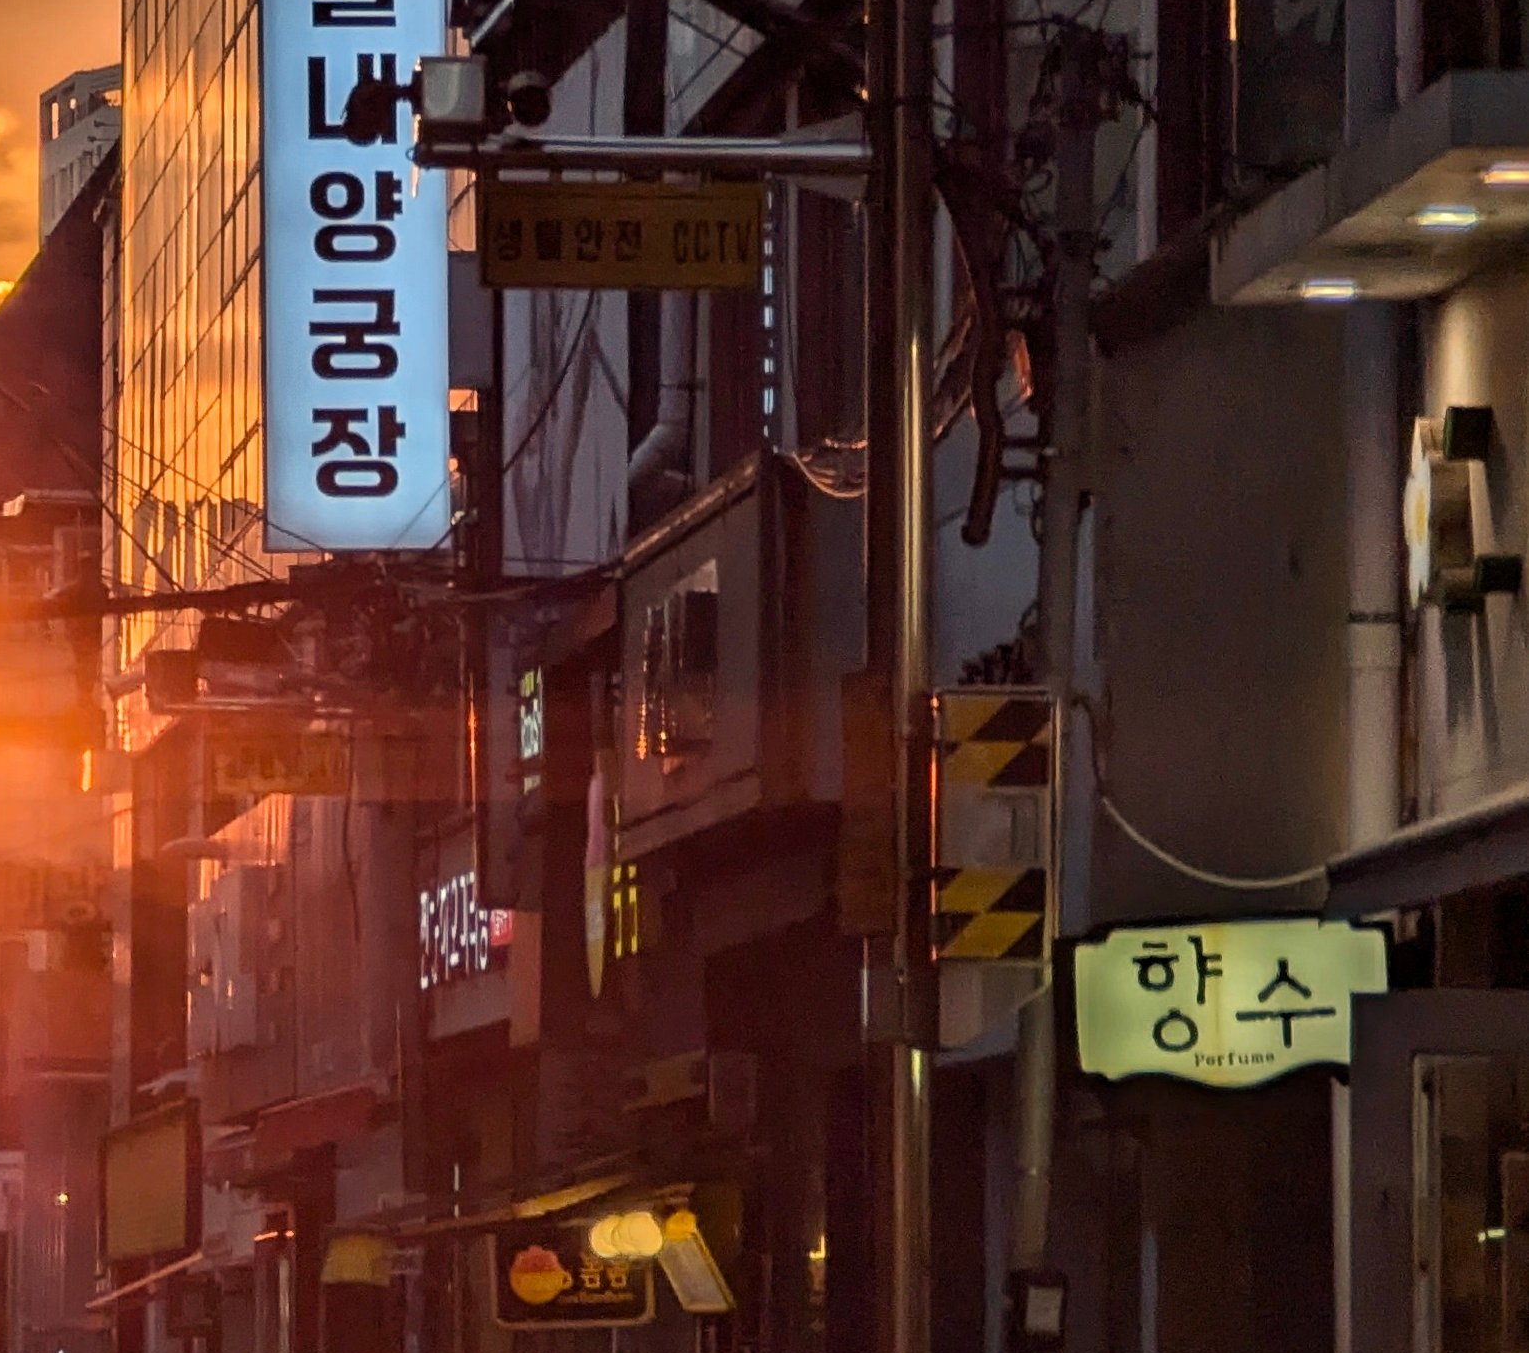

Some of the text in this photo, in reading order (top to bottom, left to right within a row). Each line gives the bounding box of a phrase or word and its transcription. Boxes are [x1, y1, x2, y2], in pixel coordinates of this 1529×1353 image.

[673, 217, 758, 266] CCTV
[1132, 935, 1337, 1053] 향수
[1194, 1051, 1276, 1068] Perfume
